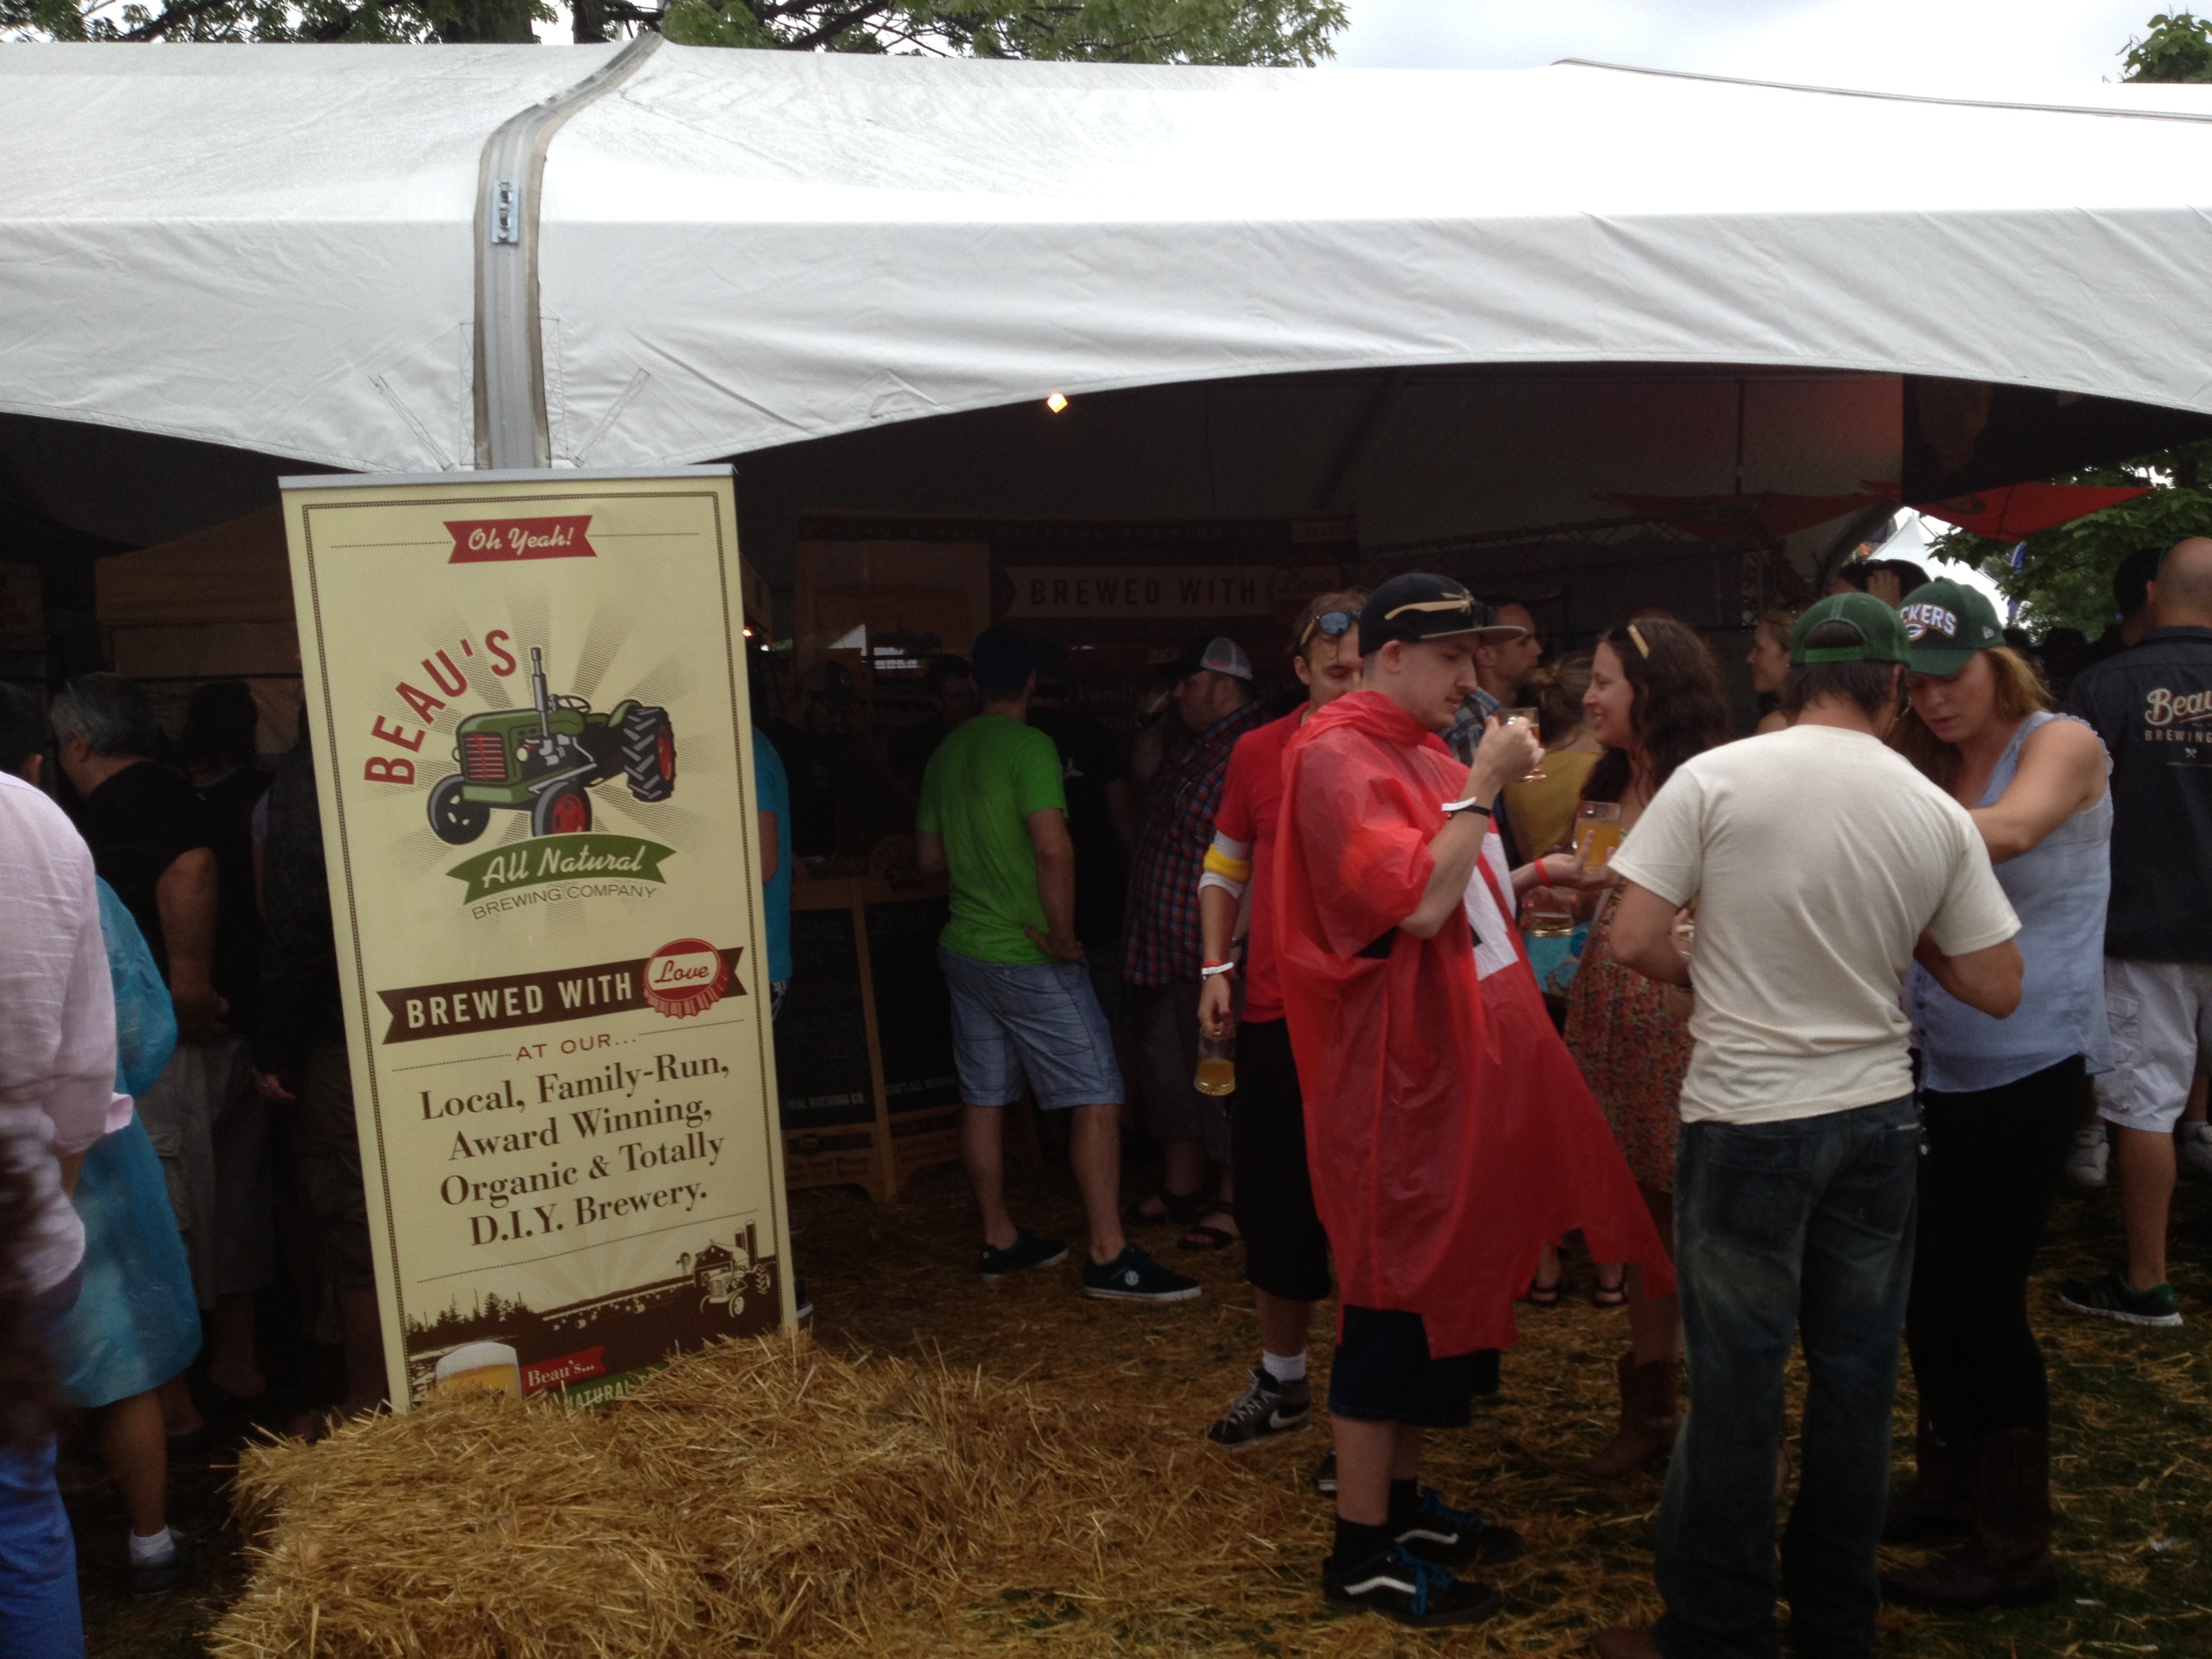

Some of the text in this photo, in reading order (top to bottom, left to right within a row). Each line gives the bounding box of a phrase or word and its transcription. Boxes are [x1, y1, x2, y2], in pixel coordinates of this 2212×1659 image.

[467, 524, 574, 550] Oh Yeah!
[1030, 577, 1160, 607] BREWED
[1179, 577, 1258, 605] WITH
[1900, 605, 1957, 636] CKERS
[364, 630, 516, 785] BEAU'S
[482, 844, 646, 888] All Natural
[472, 884, 657, 920] BREWING COMPANY
[407, 960, 710, 1028] BREWED WITH Love
[516, 1033, 636, 1061] AT OUR...
[418, 1052, 730, 1120] Local, Family-Run,
[448, 1097, 712, 1160] Award Winning,
[440, 1130, 725, 1208] Organic & Totally
[468, 1181, 708, 1246] D.I.Y. Brewery.
[527, 1361, 596, 1389] Beau's...
